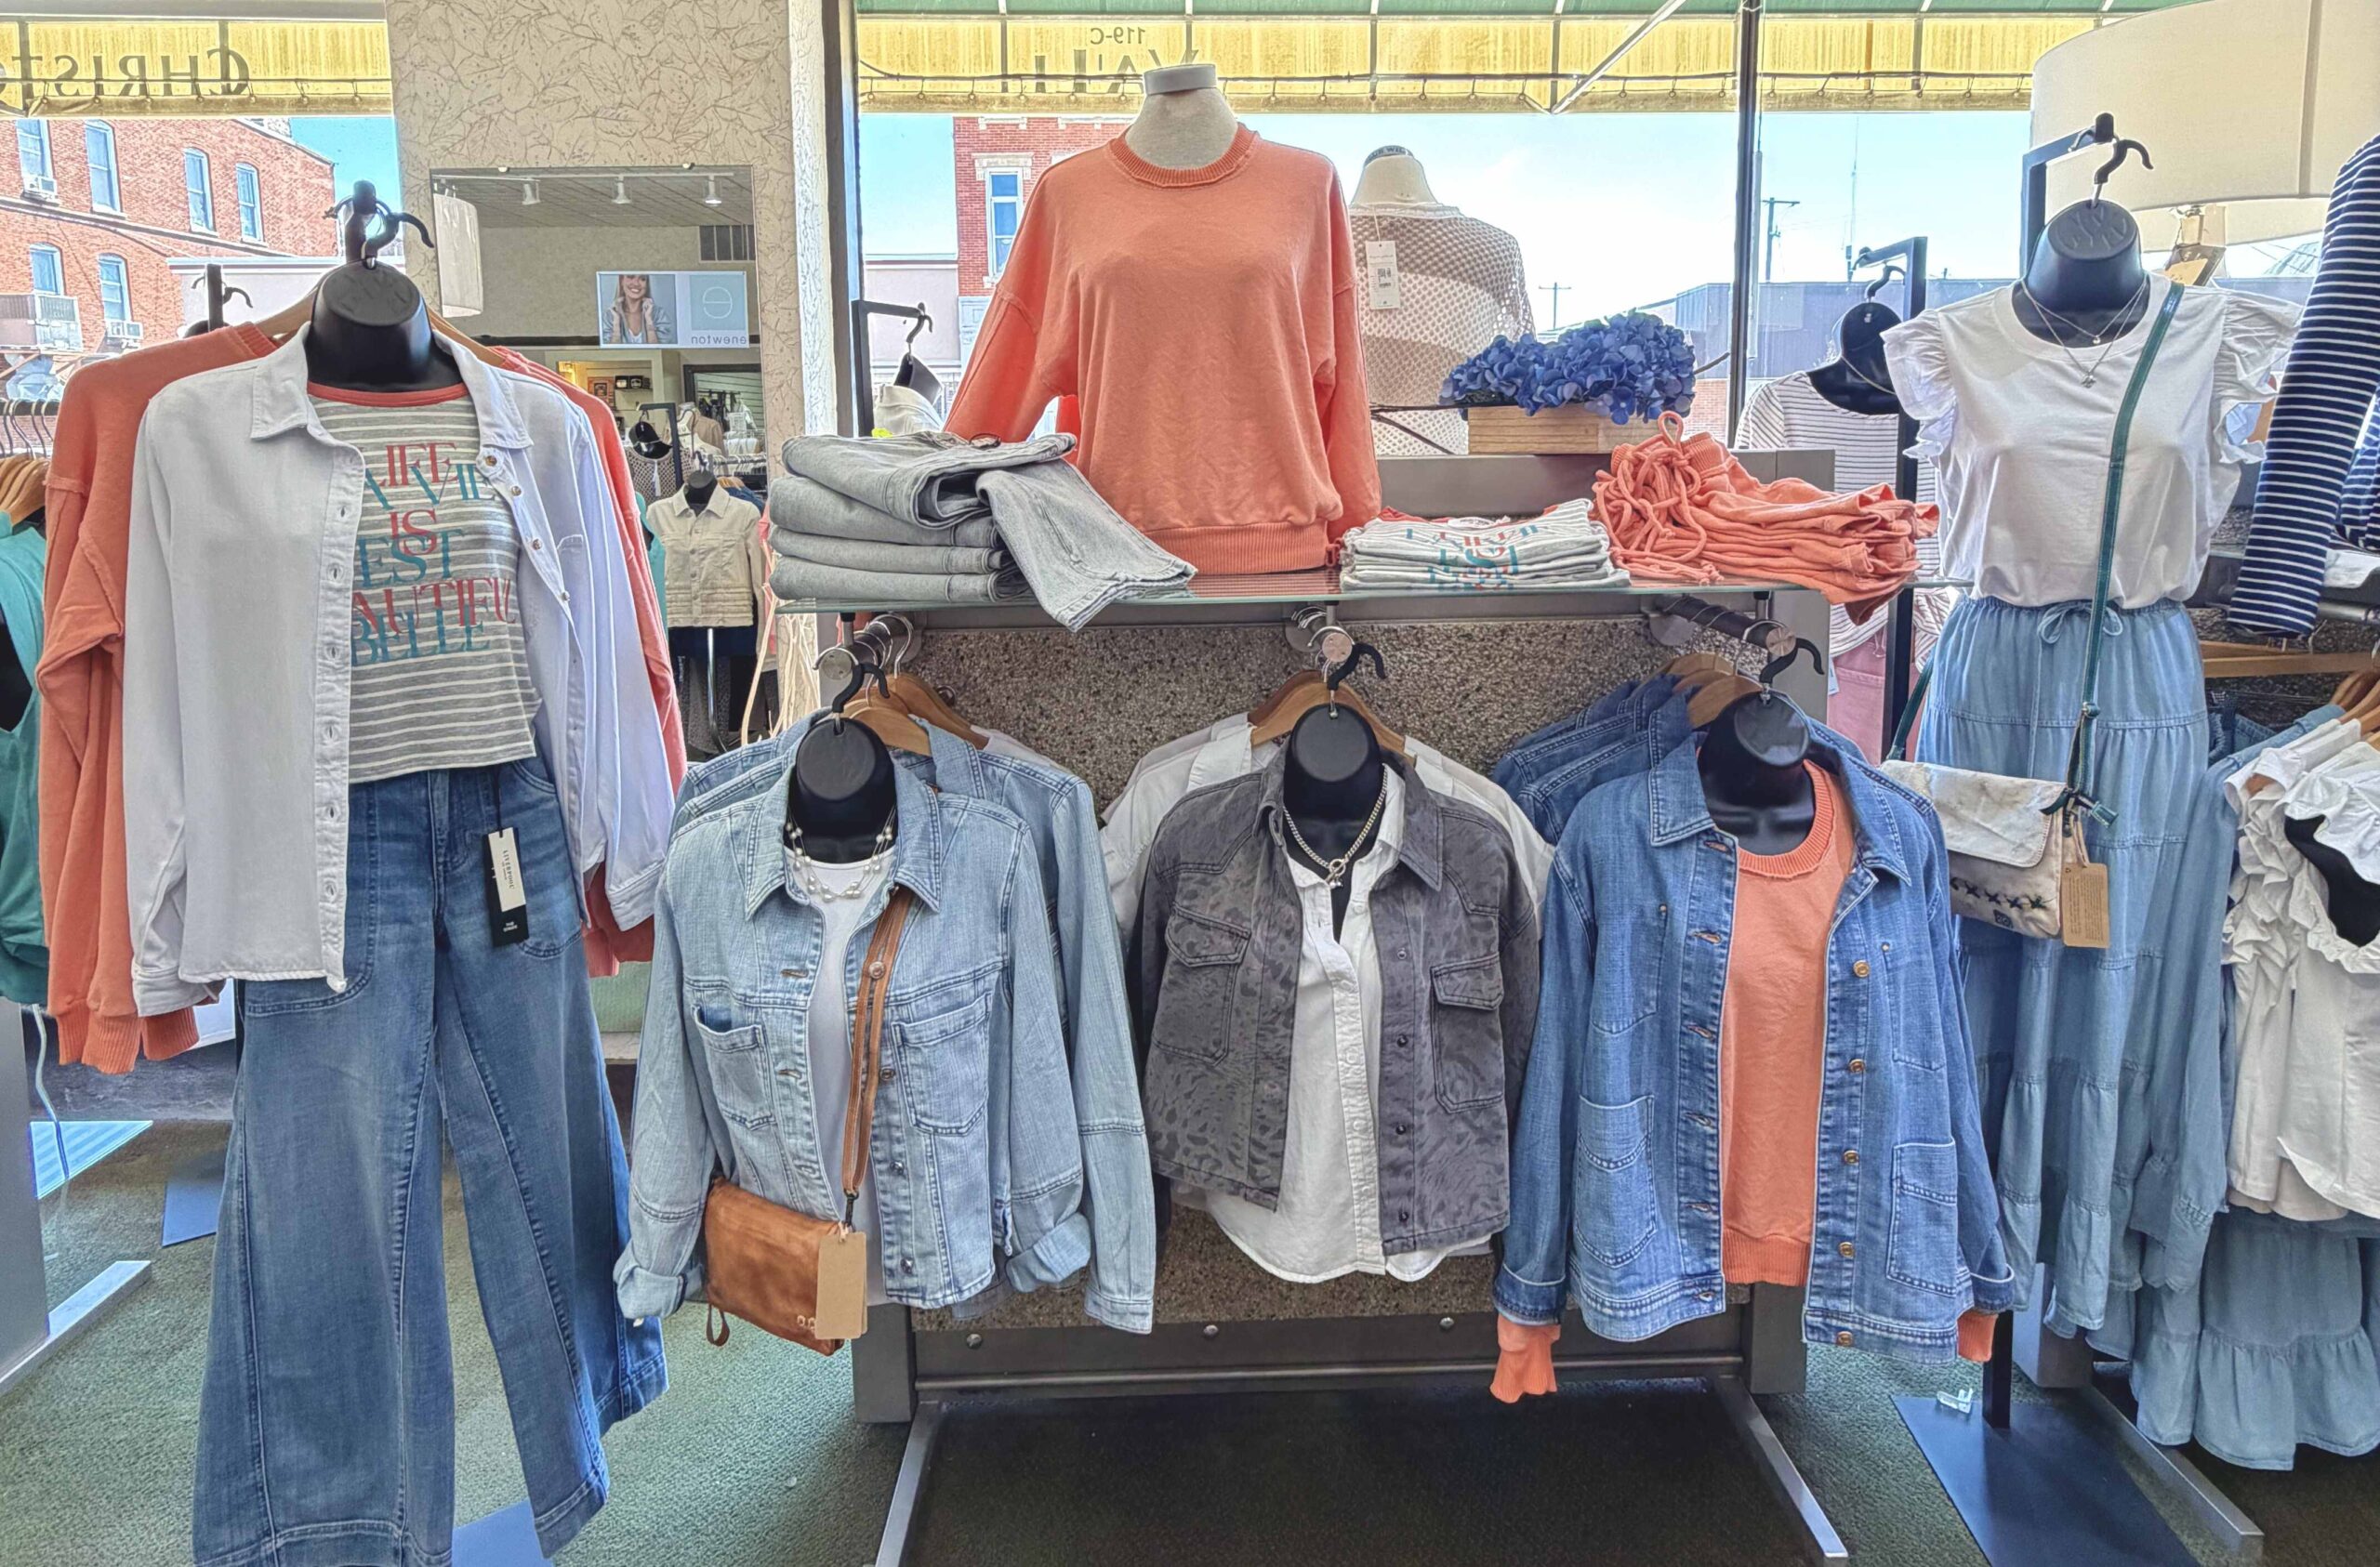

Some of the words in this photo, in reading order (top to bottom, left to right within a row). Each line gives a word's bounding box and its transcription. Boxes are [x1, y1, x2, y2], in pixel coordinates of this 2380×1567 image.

[378, 442, 456, 487] IFE
[356, 528, 465, 588] EST
[388, 507, 437, 556] IS
[351, 604, 490, 666] BELLE
[352, 576, 516, 635] AUTIFU
